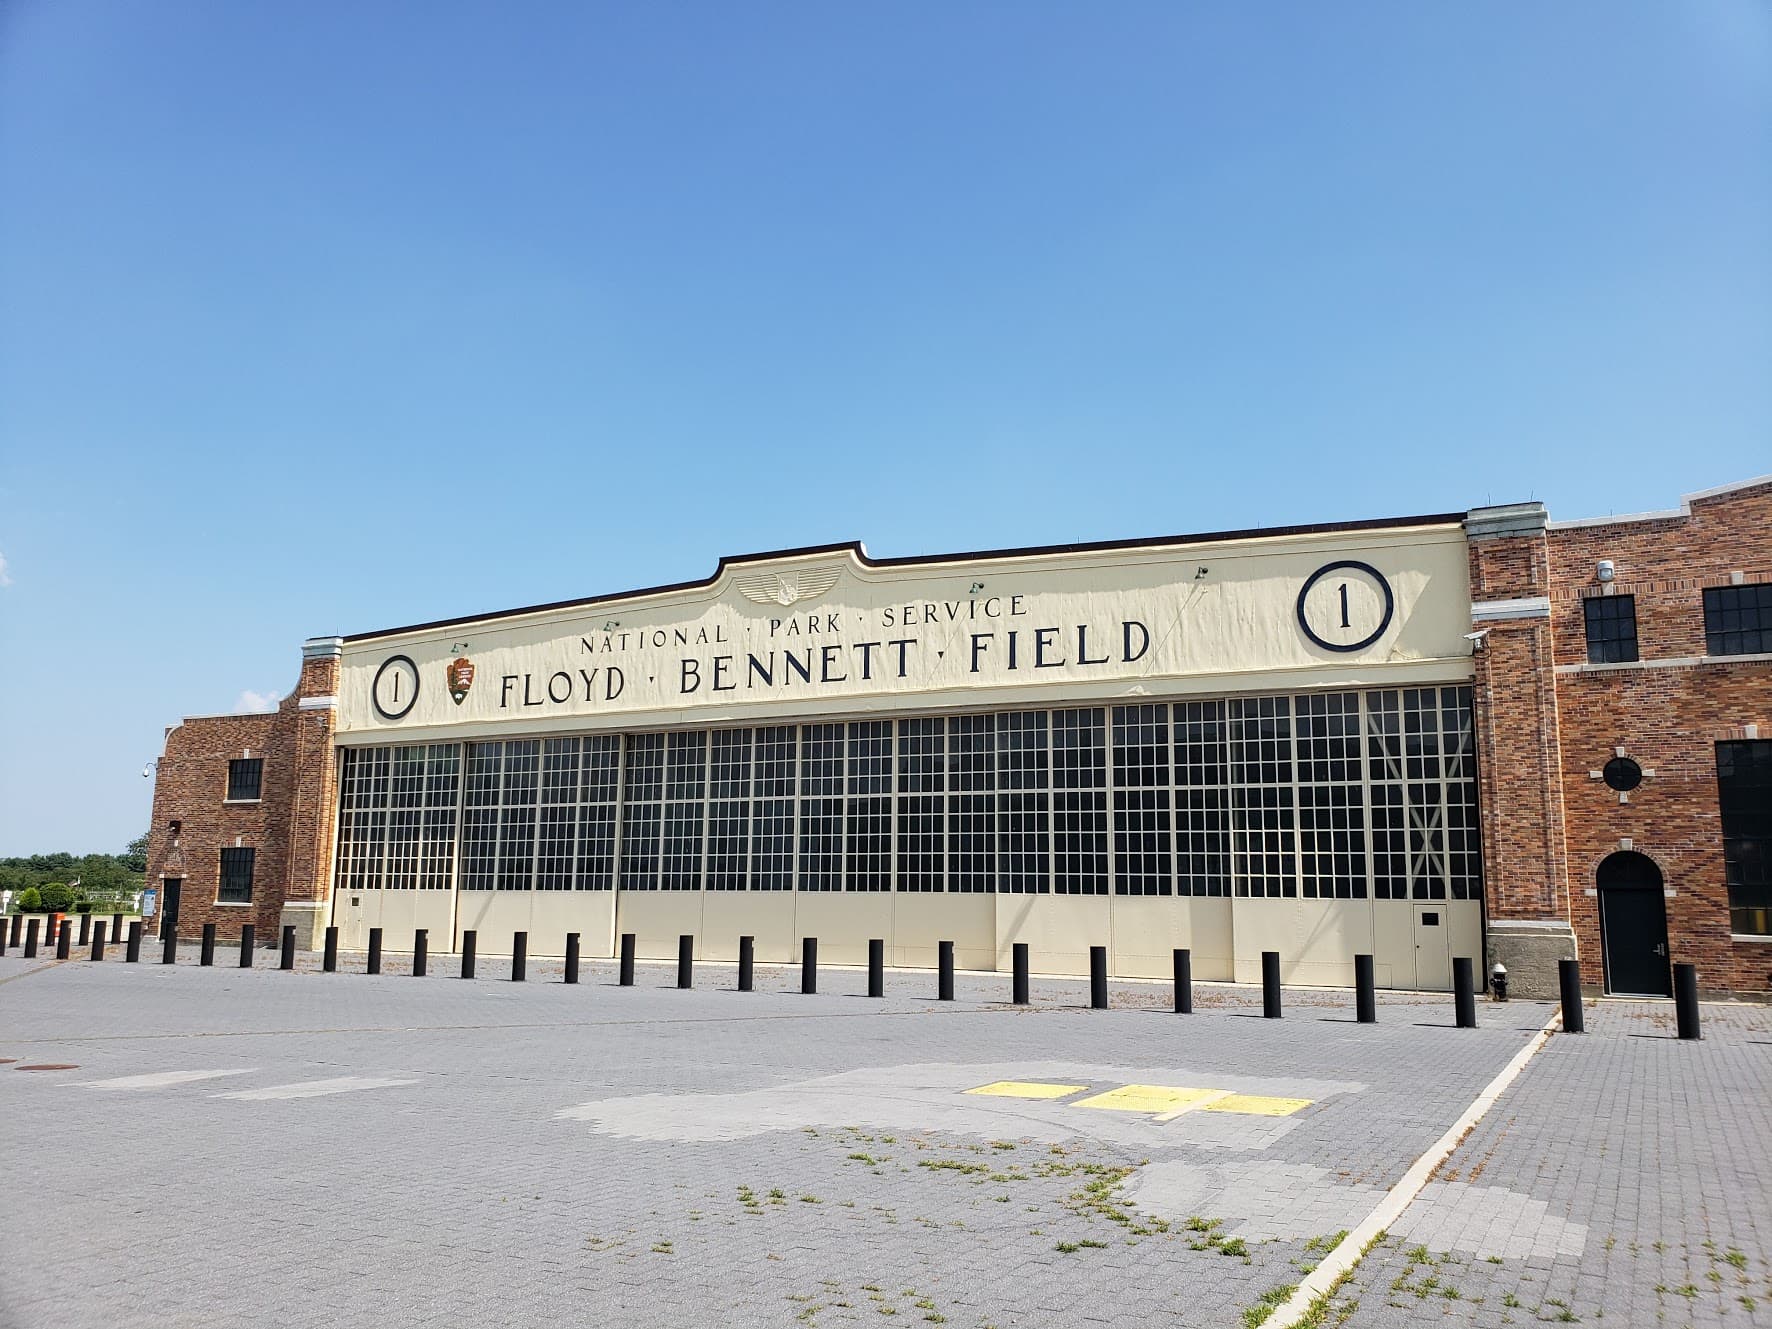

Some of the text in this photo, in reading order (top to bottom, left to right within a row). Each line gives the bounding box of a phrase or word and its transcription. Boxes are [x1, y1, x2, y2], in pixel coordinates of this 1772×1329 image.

[581, 594, 1027, 654] NATIONAL PARK SERVICE
[1338, 583, 1351, 629] 1
[393, 671, 399, 703] 1
[499, 621, 1150, 708] FLOYD BENNETT FIELD
